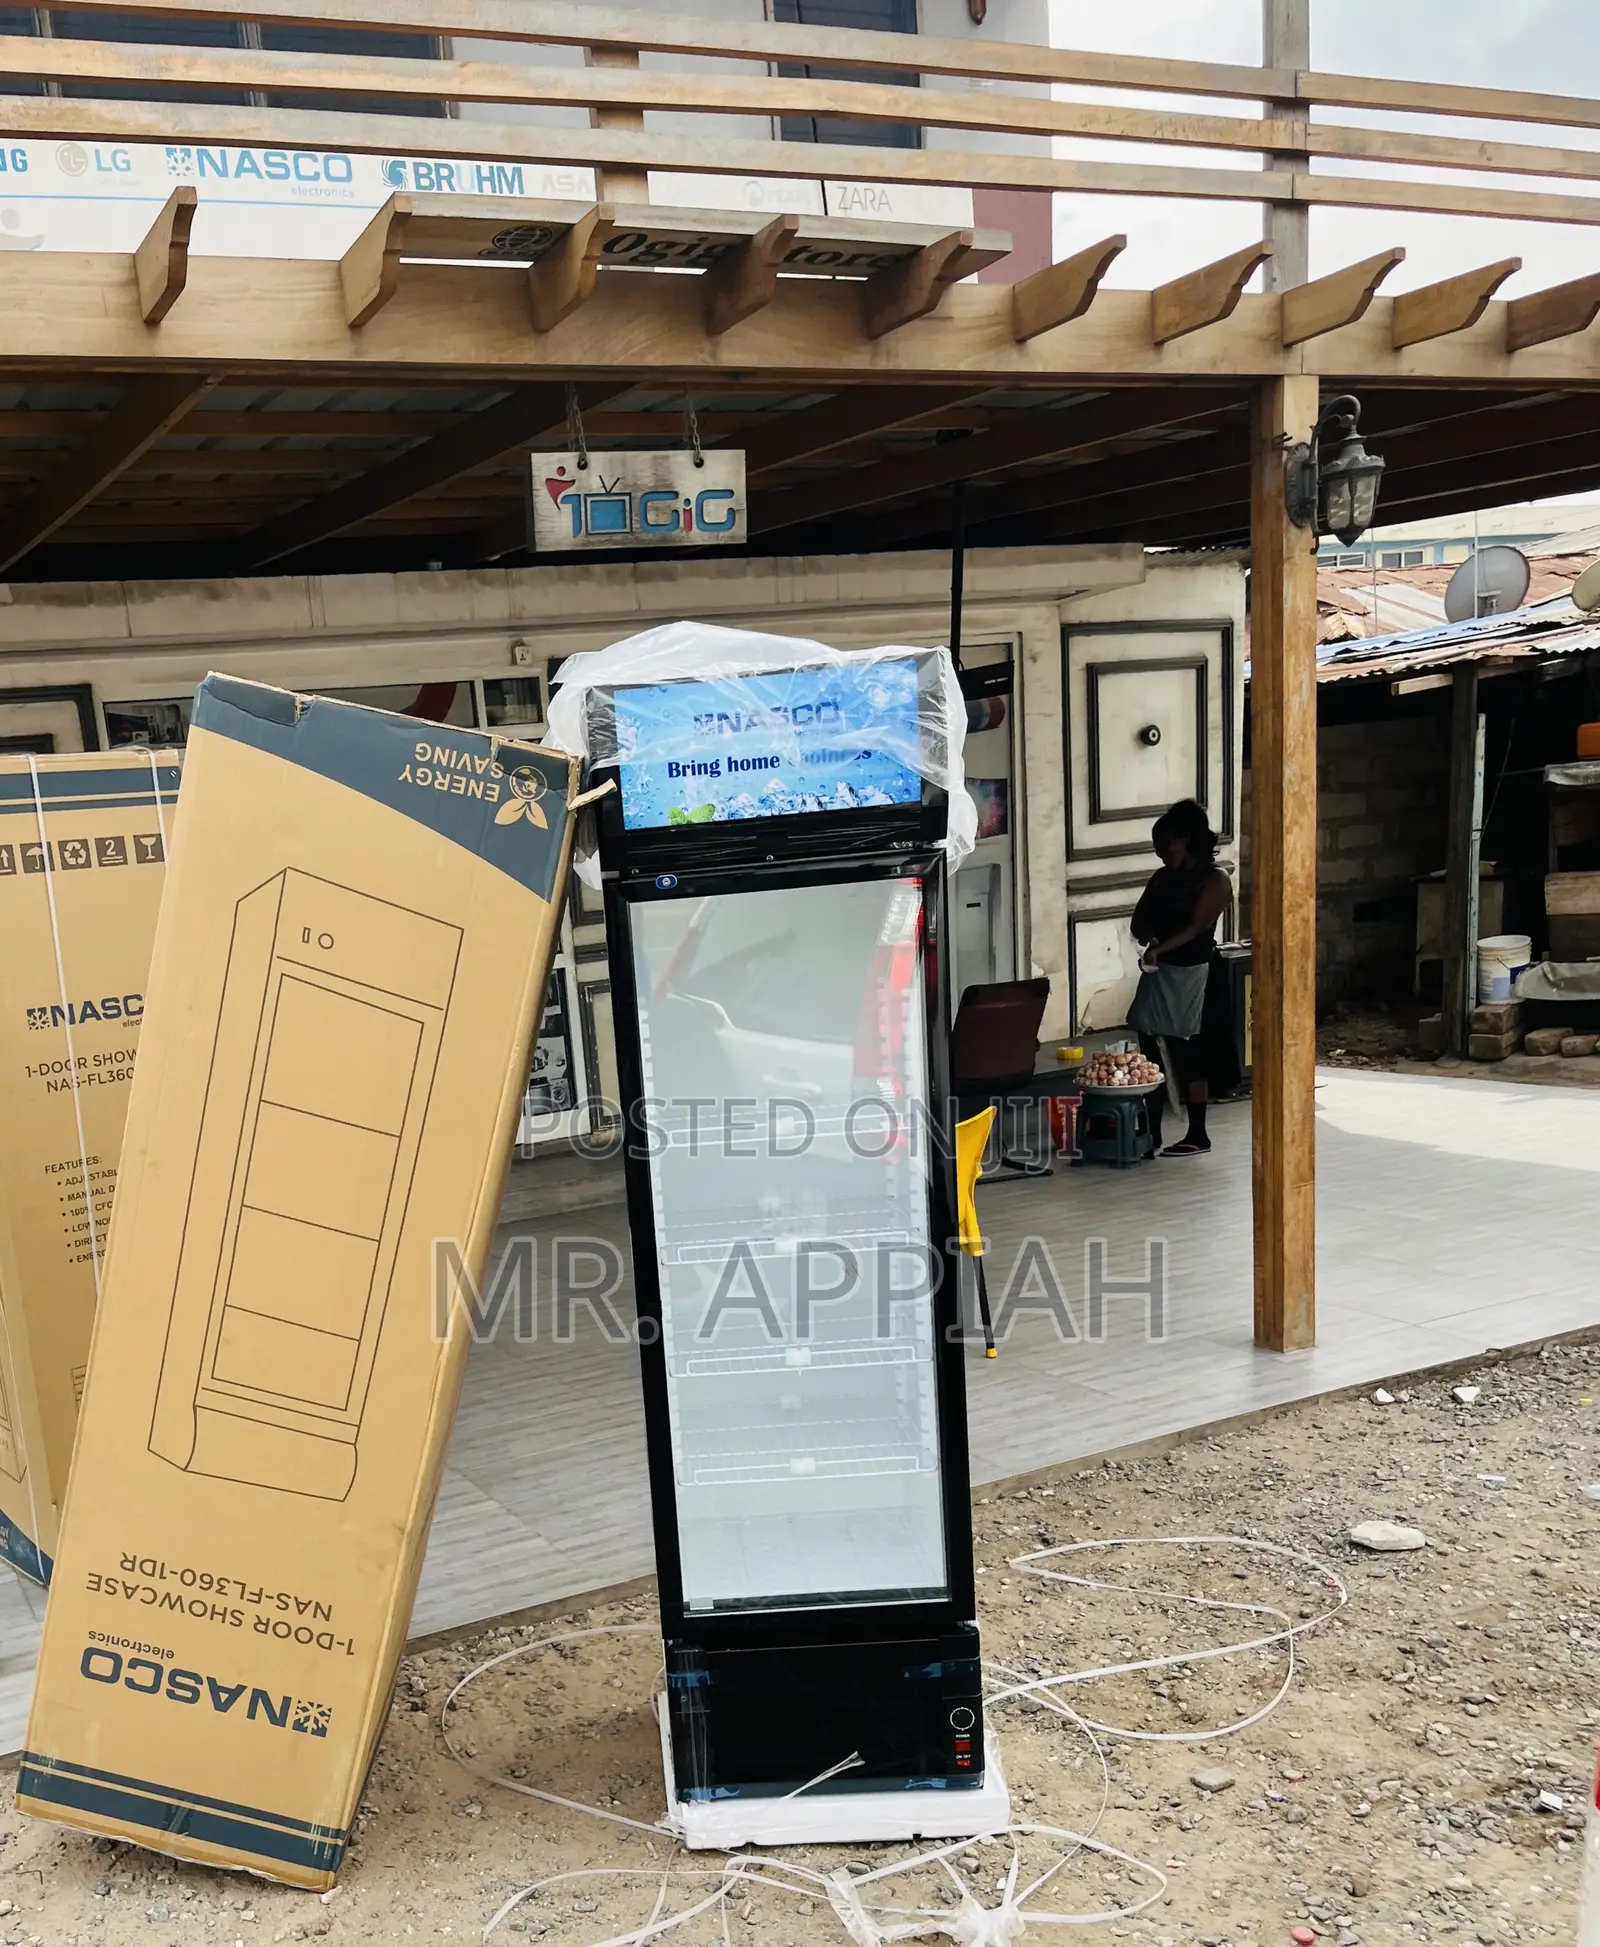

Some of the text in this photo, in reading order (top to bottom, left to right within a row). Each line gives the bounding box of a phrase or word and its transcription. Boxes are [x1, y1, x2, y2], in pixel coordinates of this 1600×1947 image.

[94, 148, 131, 172] LG
[197, 148, 353, 183] NASCO
[292, 186, 355, 199] electronics
[414, 161, 525, 195] BRUHM
[838, 185, 893, 214] ZARA
[784, 243, 902, 267] tore
[414, 742, 504, 779] SAVING
[668, 757, 721, 779] Bring
[727, 755, 780, 773] home
[398, 763, 501, 803] ENERGY
[50, 994, 145, 1028] NASC
[92, 1048, 138, 1068] SHOW
[46, 1067, 135, 1094] NAS-FL360
[119, 1552, 333, 1622] NAS-FL360-1DR
[86, 1572, 355, 1656] 1-DOOR SHOWCASE
[88, 1630, 175, 1660] electronics
[80, 1646, 293, 1729] NASCO
